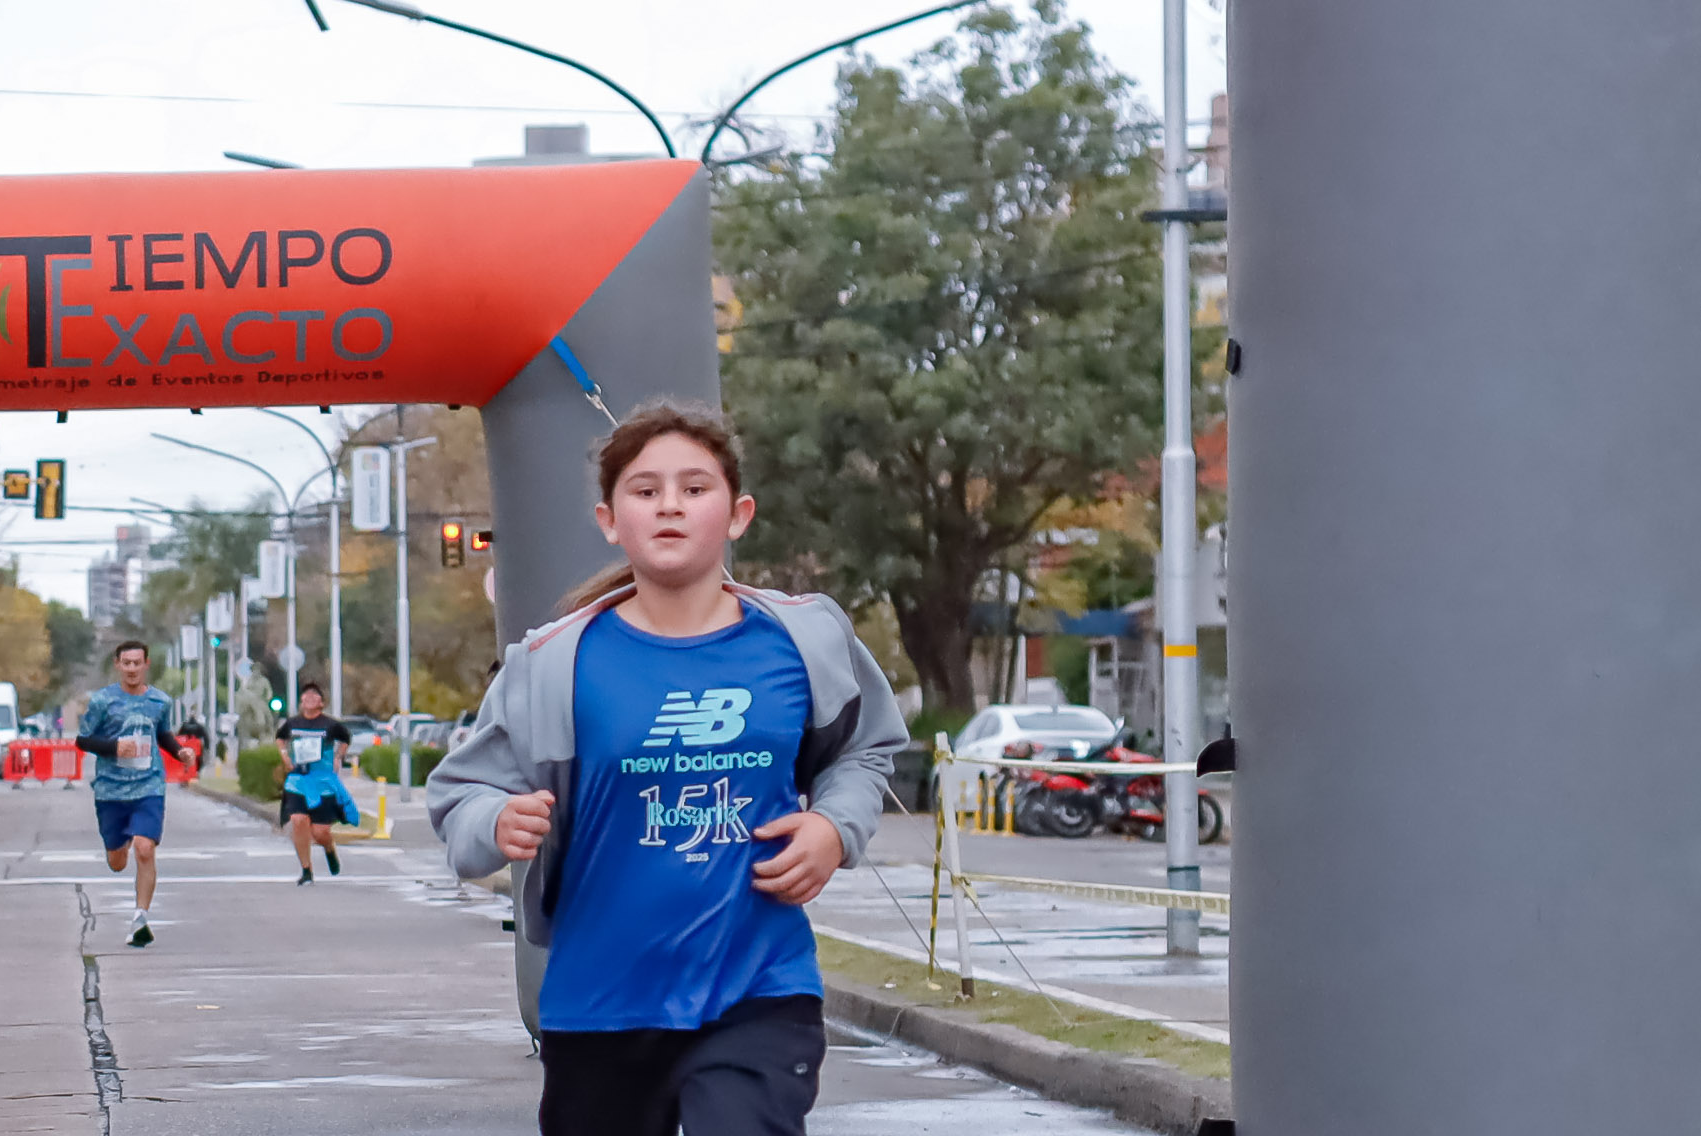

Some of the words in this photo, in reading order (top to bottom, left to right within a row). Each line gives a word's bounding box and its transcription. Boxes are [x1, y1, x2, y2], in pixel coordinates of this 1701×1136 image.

[107, 374, 138, 387] de
[152, 372, 244, 386] Eventos
[257, 369, 385, 386] Deportivos
[642, 688, 752, 746] NB
[621, 756, 670, 773] new
[674, 751, 773, 773] balance
[649, 801, 738, 827] Rosario
